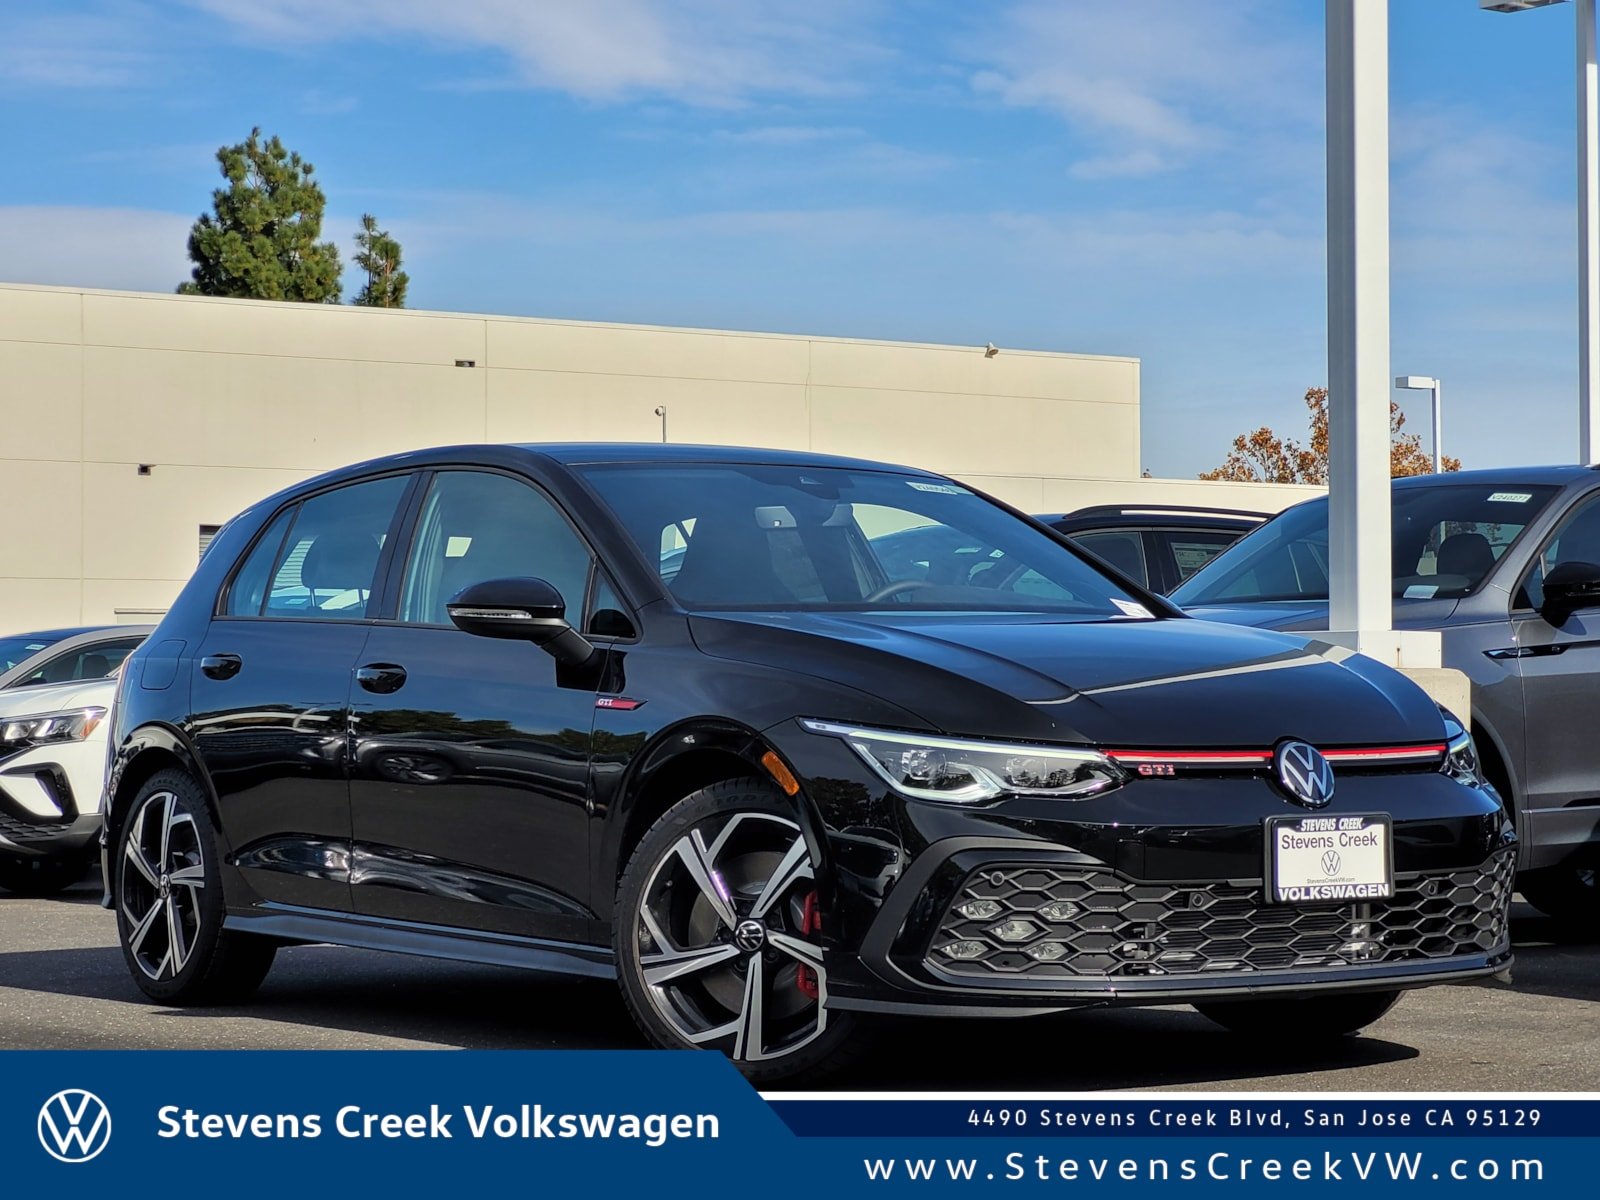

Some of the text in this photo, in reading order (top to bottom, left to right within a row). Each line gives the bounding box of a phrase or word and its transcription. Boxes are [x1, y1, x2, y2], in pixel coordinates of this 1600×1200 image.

[598, 698, 613, 706] GTI
[1138, 763, 1175, 776] GTI
[1301, 817, 1363, 832] STEVENS CREEK
[1281, 832, 1378, 850] Stevens Creek
[1278, 884, 1389, 901] VOLKSWAGEN
